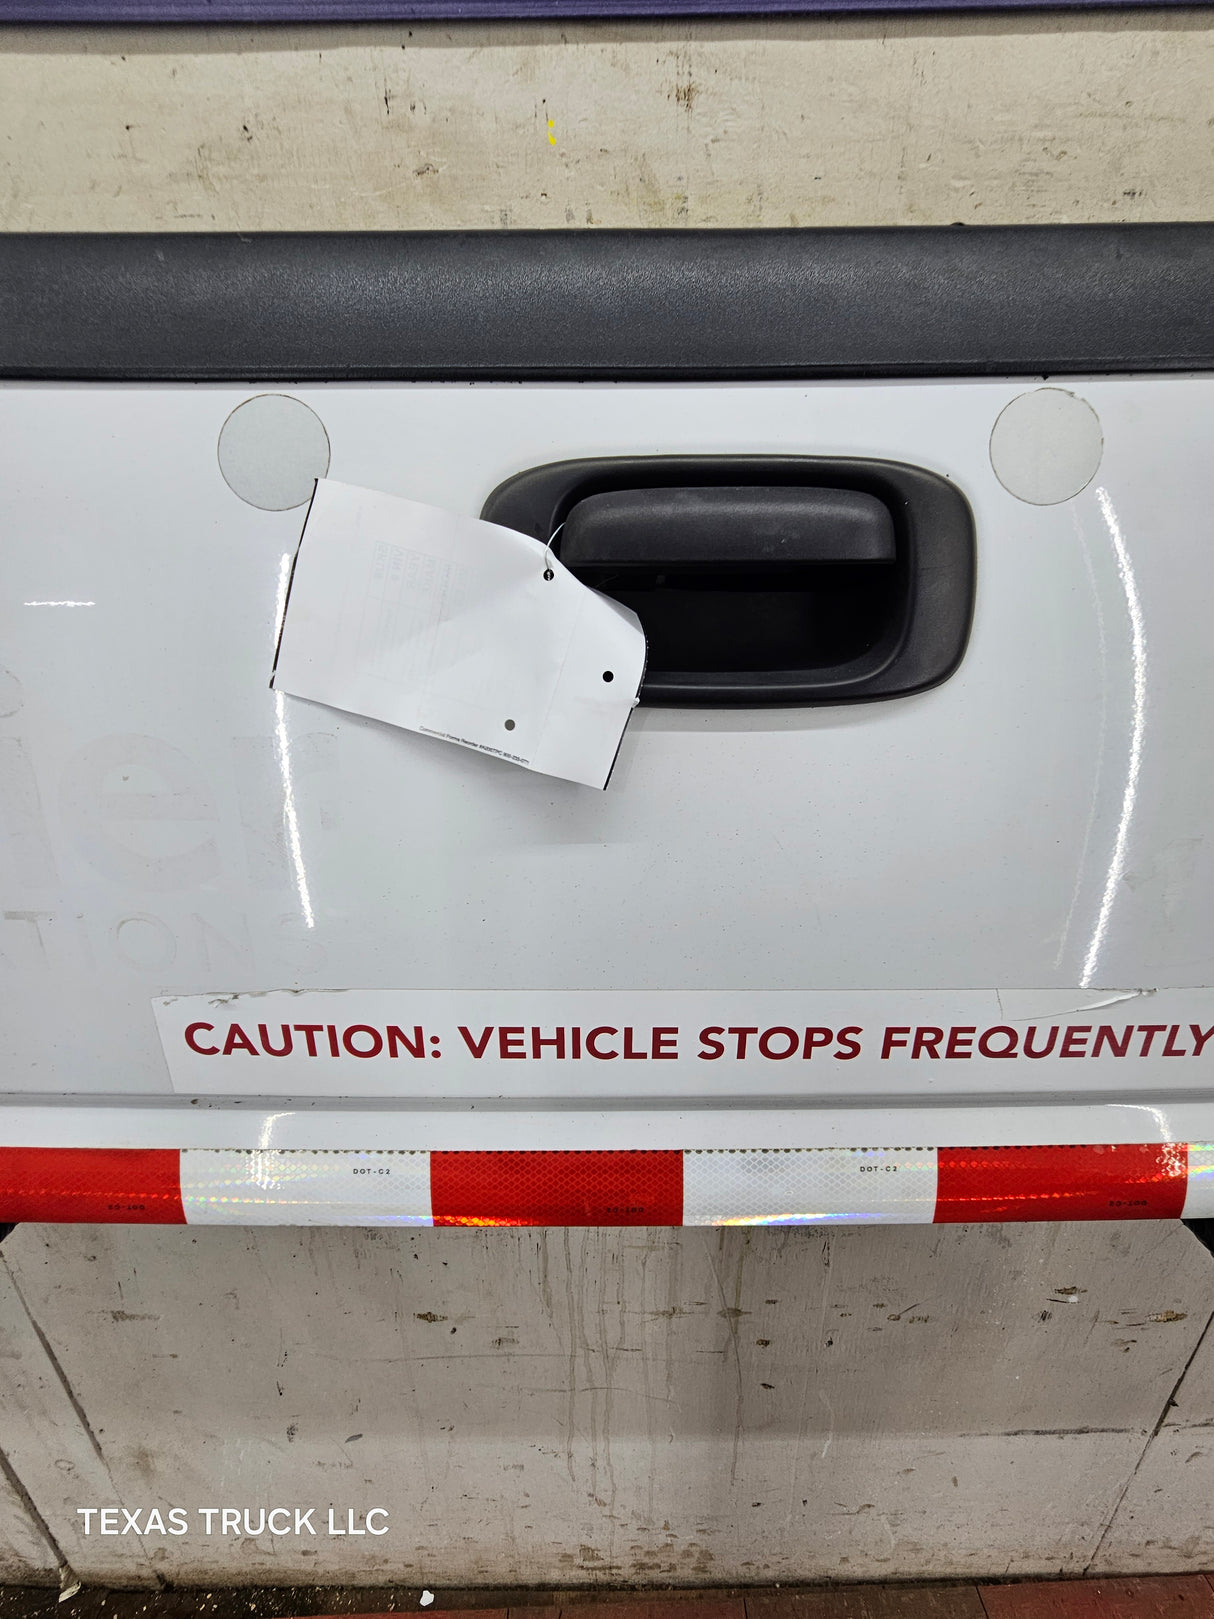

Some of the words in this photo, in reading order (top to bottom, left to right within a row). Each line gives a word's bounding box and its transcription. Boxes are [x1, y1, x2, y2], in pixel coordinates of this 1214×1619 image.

[185, 1022, 441, 1058] CAUTION:
[458, 1026, 678, 1059] VEHICLE
[698, 1026, 862, 1059] STOPS
[881, 1024, 1214, 1059] FREQUENTLY
